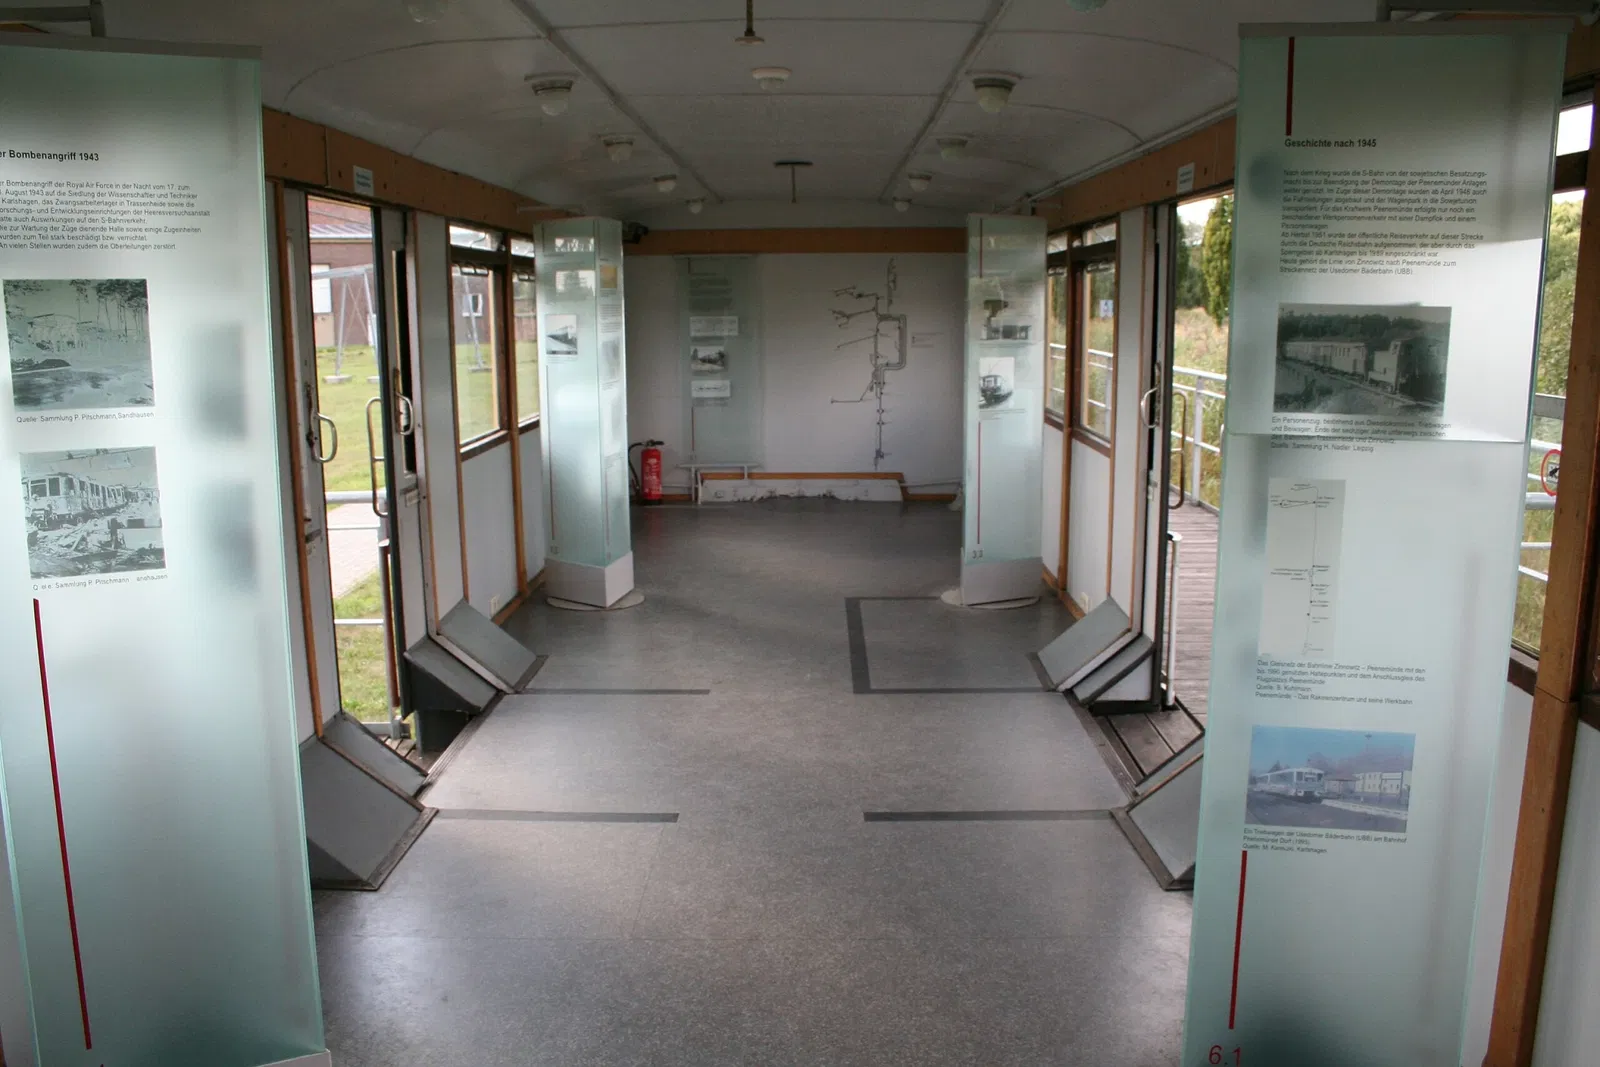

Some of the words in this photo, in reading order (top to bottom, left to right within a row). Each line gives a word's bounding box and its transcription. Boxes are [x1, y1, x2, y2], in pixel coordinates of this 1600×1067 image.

[1284, 138, 1332, 148] Geschichte
[1334, 138, 1354, 148] nach
[1357, 139, 1376, 148] 1945
[8, 149, 76, 163] Bombenangriff
[78, 152, 100, 162] 1943
[6, 180, 52, 190] Bombenangriff
[66, 181, 84, 190] Royal
[1462, 179, 1488, 188] Anlagen
[4, 188, 28, 198] August
[68, 190, 96, 199] Siedlung
[2, 198, 40, 207] Karlshagen,
[55, 199, 118, 208] Zwangsarbeiterlager
[50, 208, 132, 217] Entwicklungseinrichtungen
[30, 216, 76, 225] Auswirkungen
[20, 224, 48, 234] Wartung
[61, 225, 78, 234] Züge
[144, 226, 162, 235] einige
[164, 226, 202, 235] Zugeinheiten
[67, 234, 101, 243] beschädigt
[110, 243, 152, 252] Oberleitungen
[40, 414, 73, 422] Sammlung
[136, 574, 168, 582] andhausen
[1208, 1044, 1242, 1067] 6.1
